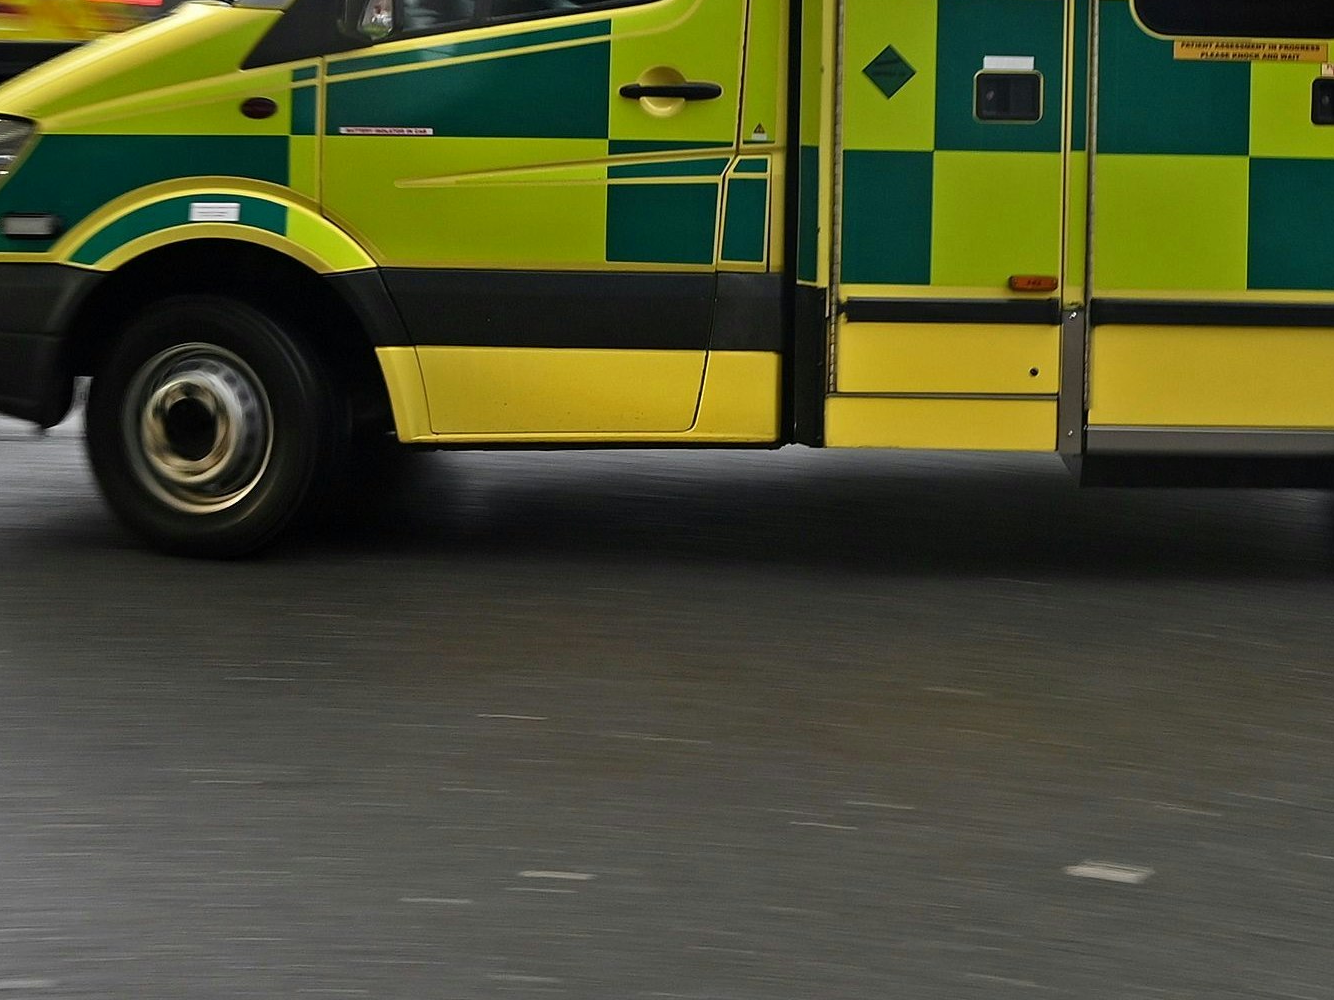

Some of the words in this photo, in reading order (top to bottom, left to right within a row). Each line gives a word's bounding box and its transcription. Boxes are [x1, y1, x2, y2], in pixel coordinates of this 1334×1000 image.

[1181, 41, 1214, 49] PATIENT
[1215, 42, 1267, 50] ASSESSMENT
[1278, 43, 1321, 51] PROGRESS
[1200, 51, 1230, 59] PLEASE
[1232, 52, 1260, 60] KNOCK
